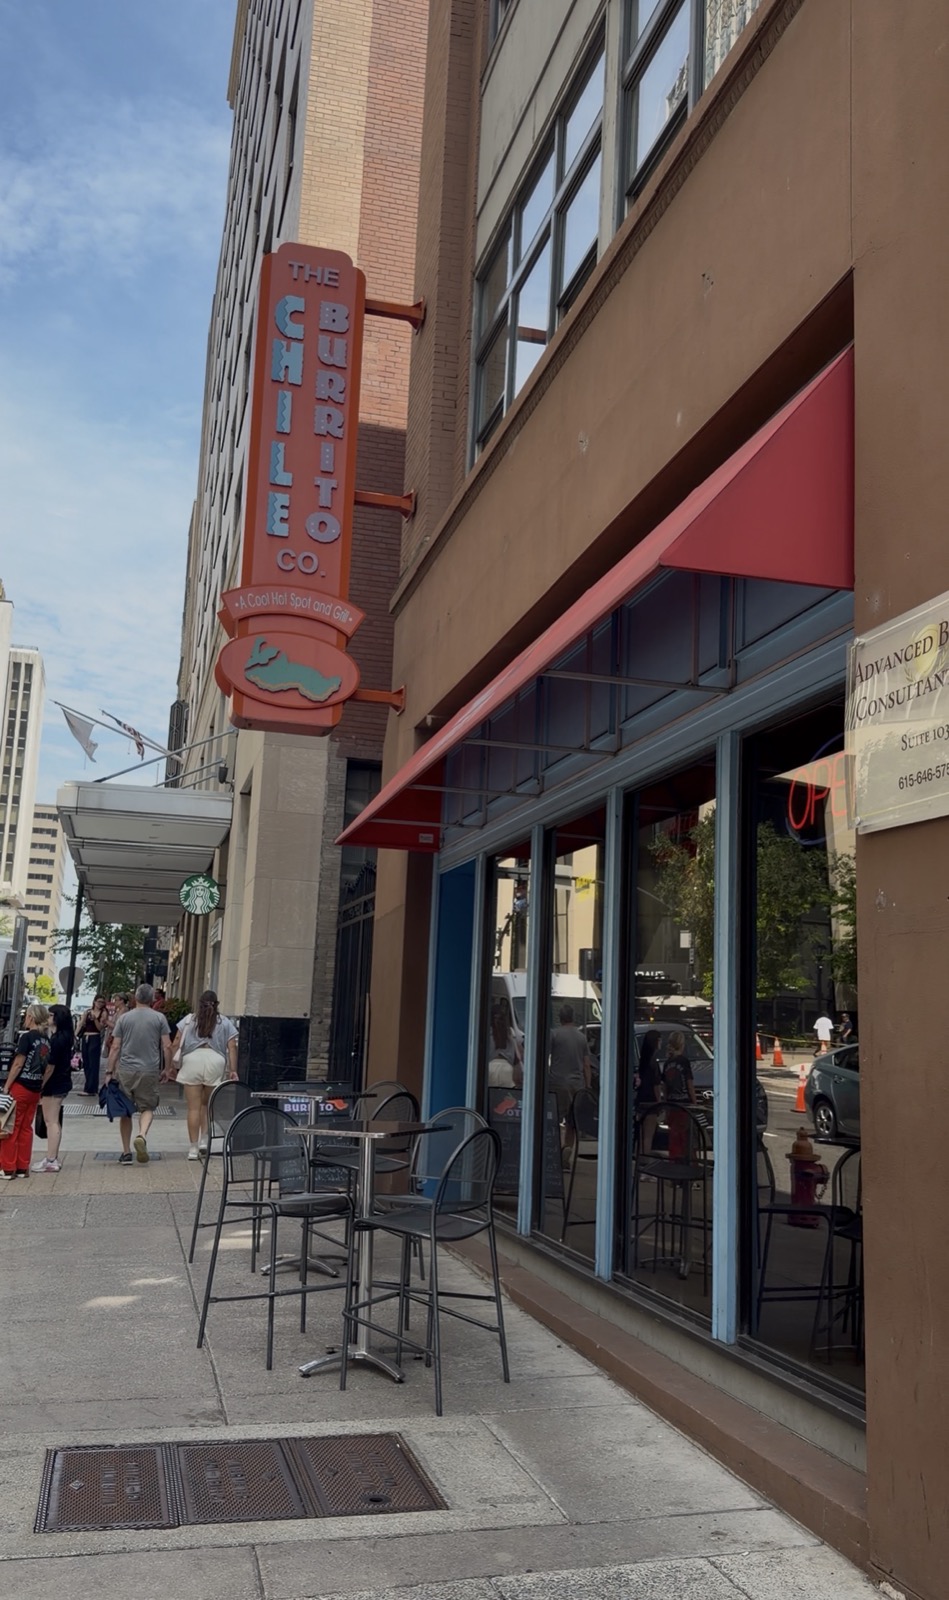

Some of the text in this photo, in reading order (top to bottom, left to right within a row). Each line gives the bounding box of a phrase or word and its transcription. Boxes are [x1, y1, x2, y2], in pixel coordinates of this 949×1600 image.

[287, 259, 341, 288] THE
[265, 294, 306, 538] CHILE
[304, 300, 350, 544] BURRITO
[276, 548, 327, 578] CO.
[247, 592, 271, 608] Cool
[271, 591, 288, 605] Hot
[290, 592, 312, 610] Spot
[313, 600, 333, 616] and
[333, 605, 350, 624] Grill
[855, 634, 934, 685] ADVANCED
[855, 667, 949, 721] CONSULTAN
[901, 730, 931, 751] SUITE
[787, 749, 849, 831] OPE
[283, 1103, 334, 1112] BURTO
